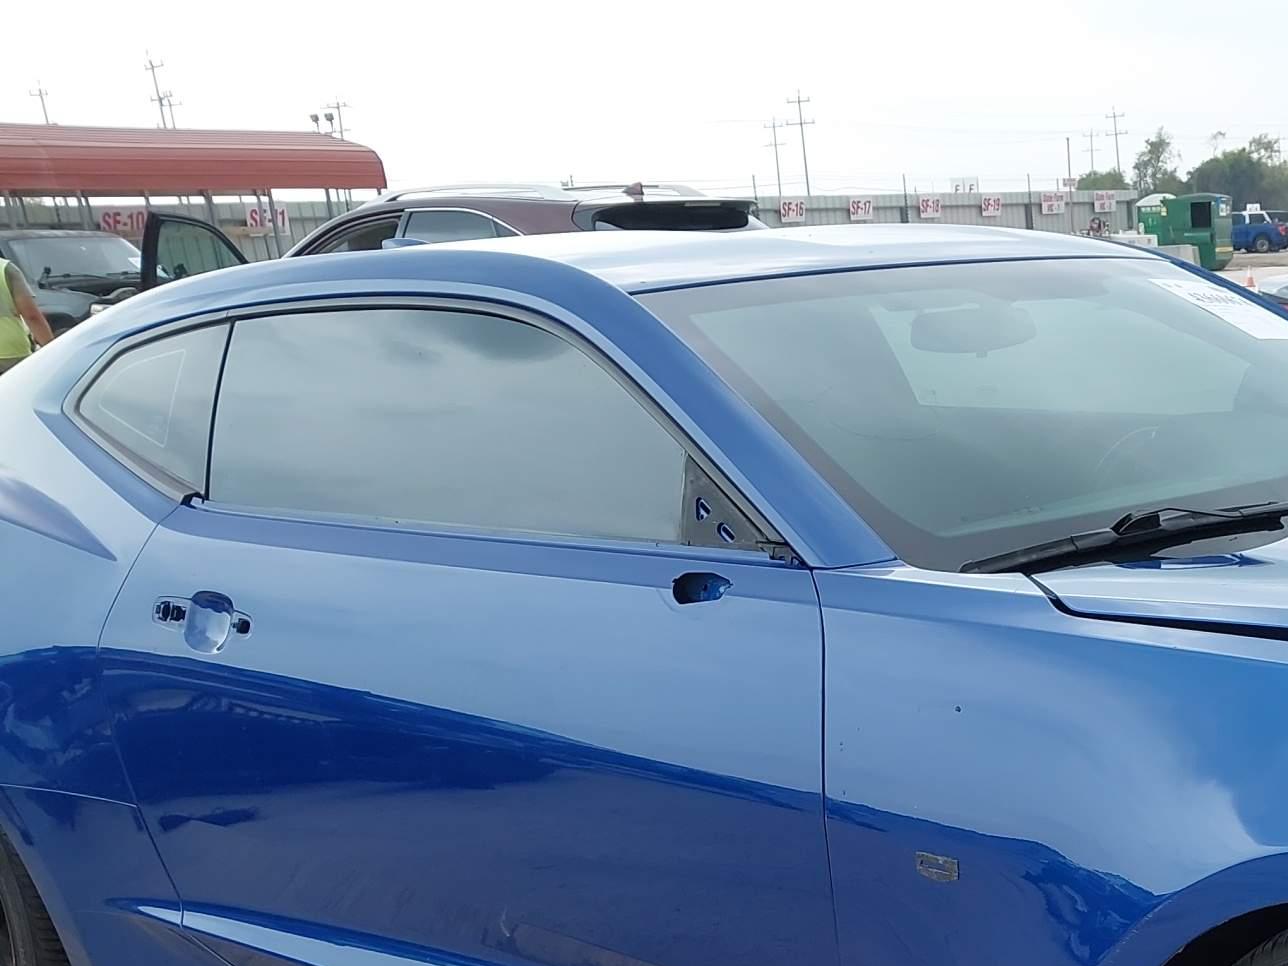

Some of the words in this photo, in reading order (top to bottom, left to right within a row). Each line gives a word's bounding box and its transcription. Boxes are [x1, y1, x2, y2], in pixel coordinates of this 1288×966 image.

[782, 201, 805, 218] SF-16
[851, 200, 872, 216] SF-17
[921, 199, 940, 214] SF-18
[983, 197, 1001, 212] SF-19
[103, 211, 145, 231] SF-10
